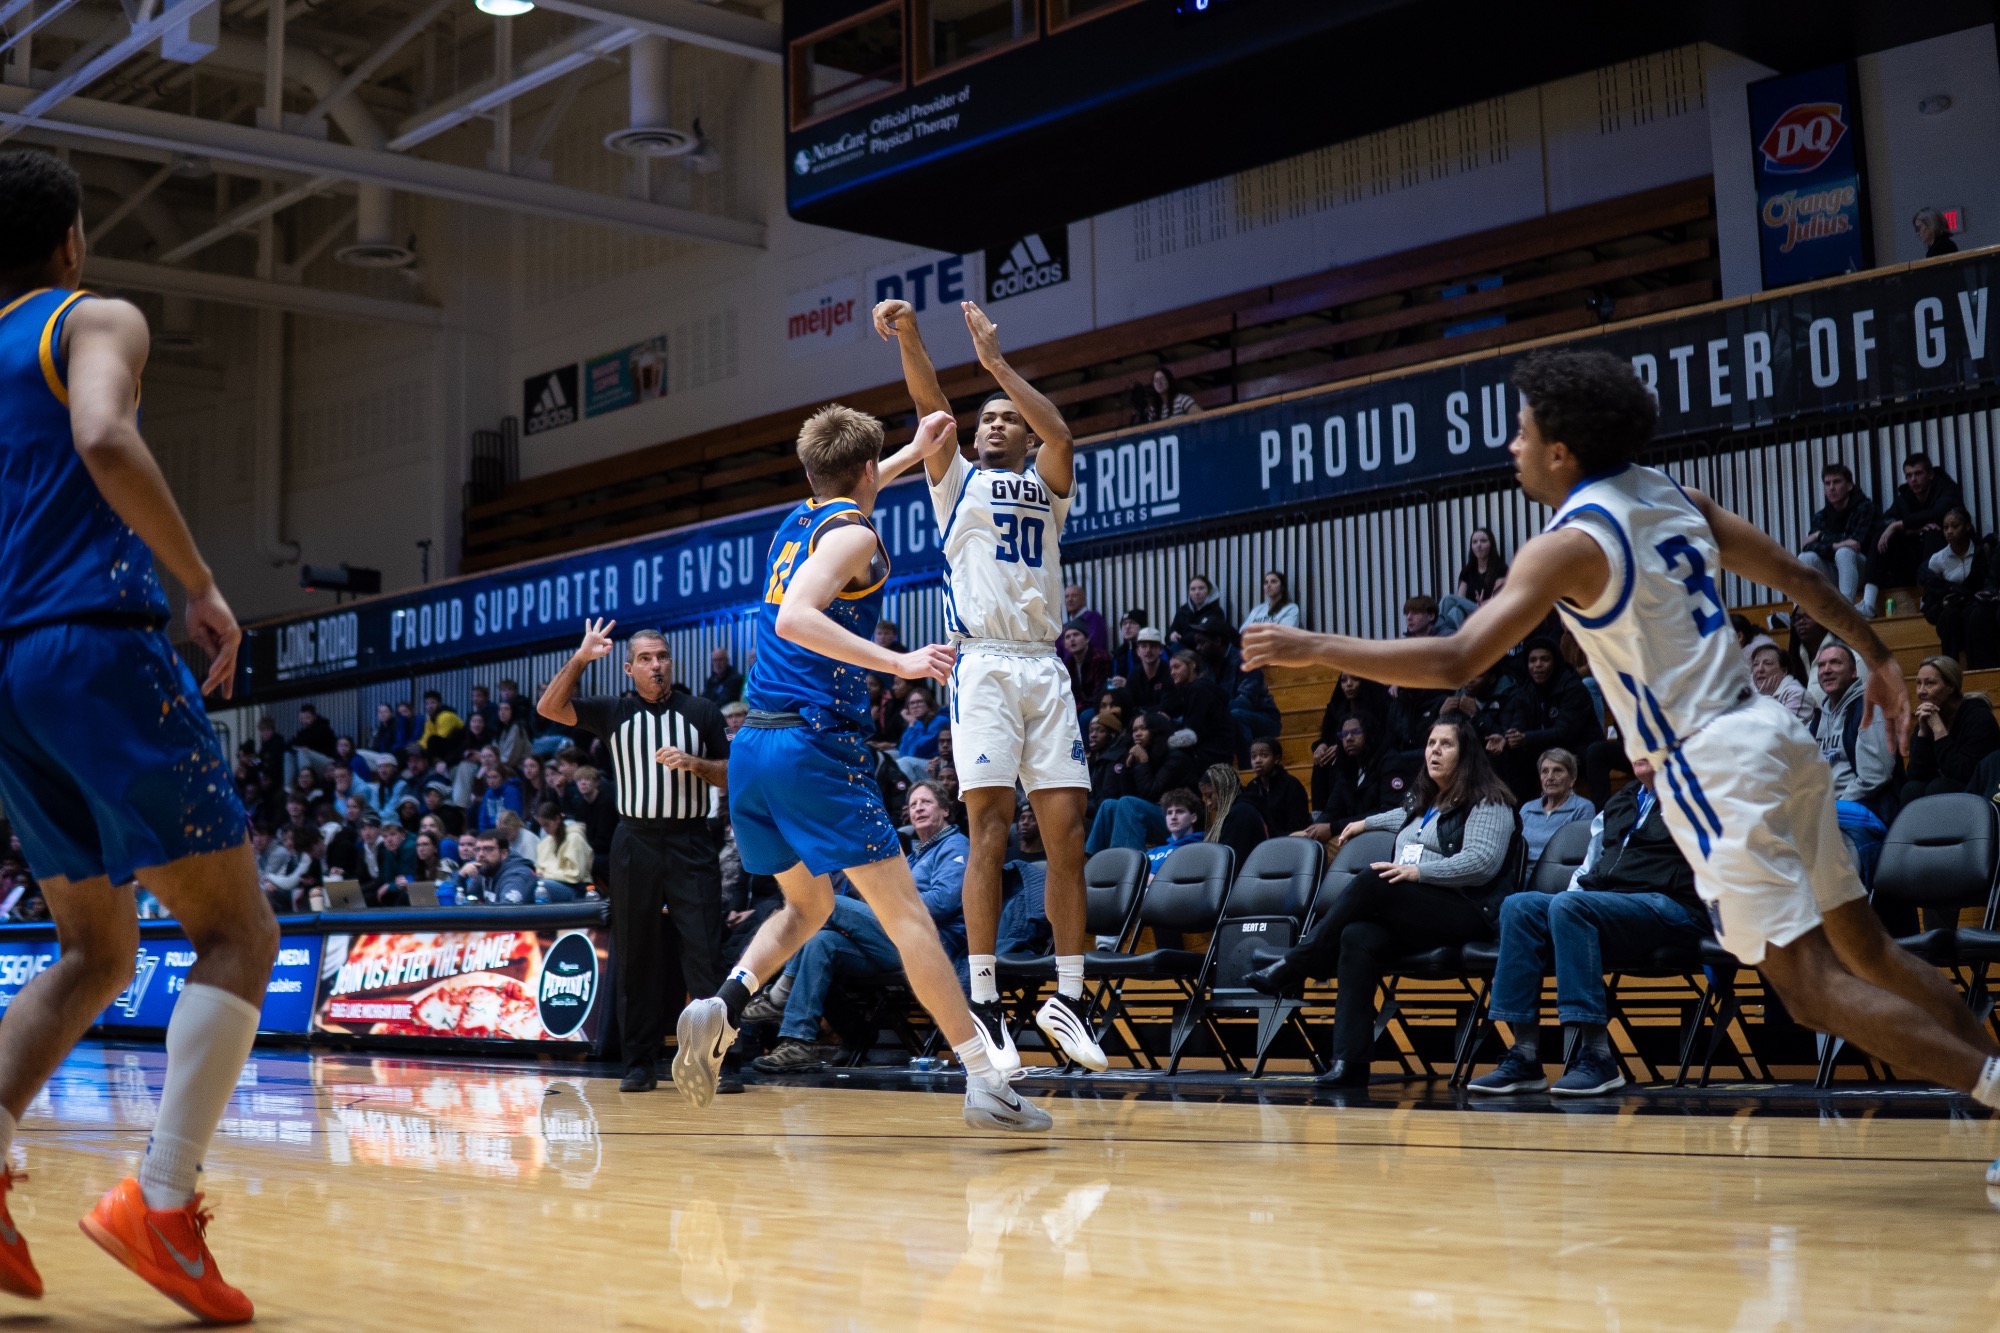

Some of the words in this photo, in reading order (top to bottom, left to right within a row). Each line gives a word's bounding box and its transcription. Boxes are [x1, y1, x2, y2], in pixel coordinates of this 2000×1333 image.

[869, 107, 910, 134] Official
[910, 94, 957, 119] Provider
[956, 84, 971, 102] of
[869, 127, 914, 154] Physical
[913, 112, 961, 138] Therapy
[1776, 116, 1833, 159] DQ
[1763, 185, 1856, 228] Orange
[991, 262, 1063, 299] adidas
[788, 298, 856, 340] meijer
[527, 406, 574, 434] adidas
[1260, 402, 1417, 490] PROUD
[1808, 308, 1876, 389] OF
[1097, 434, 1180, 514] ROAD
[993, 512, 1045, 568] 30
[391, 598, 463, 652] PROUD
[474, 565, 619, 636] SUPPORTER
[632, 555, 664, 606] OF
[678, 537, 754, 597] GVSU
[1654, 534, 1726, 638] 3
[277, 621, 315, 671] LONG
[318, 611, 358, 664] ROAD
[164, 951, 198, 967] FOLLO
[277, 949, 310, 966] MEDIA
[329, 961, 363, 996] JOIN
[363, 957, 388, 990] US
[384, 949, 432, 987] AFTER
[431, 943, 465, 978] THE
[462, 933, 516, 974] GAME!
